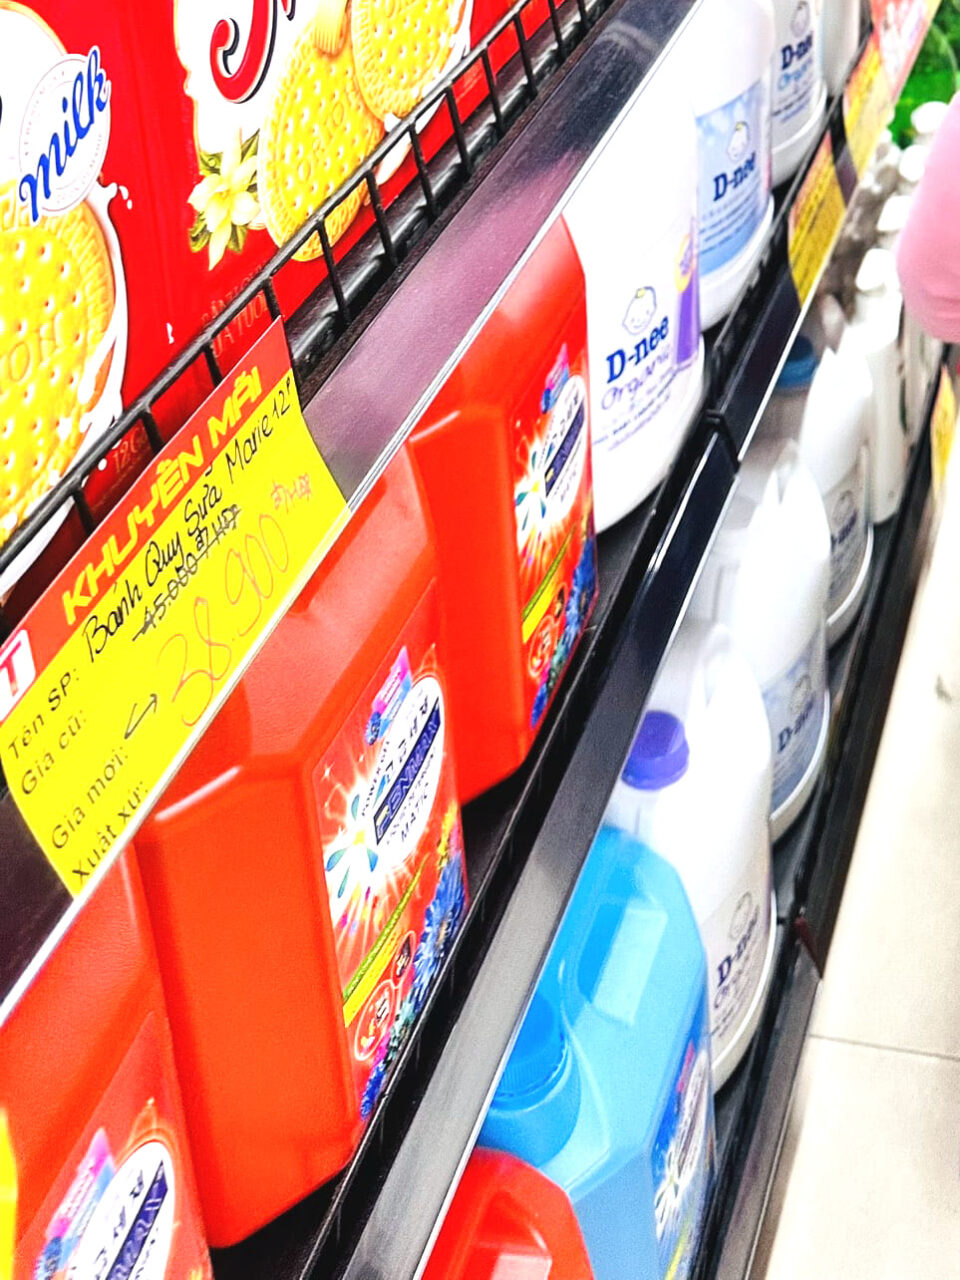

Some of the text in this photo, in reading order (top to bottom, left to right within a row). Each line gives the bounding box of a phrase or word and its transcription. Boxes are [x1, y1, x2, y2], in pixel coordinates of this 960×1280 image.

[19, 49, 107, 222] milk
[606, 316, 670, 384] D-nee
[8, 714, 46, 760] Tên
[47, 667, 80, 712] SP:
[81, 580, 143, 664] Bánh
[226, 415, 274, 485] Marie
